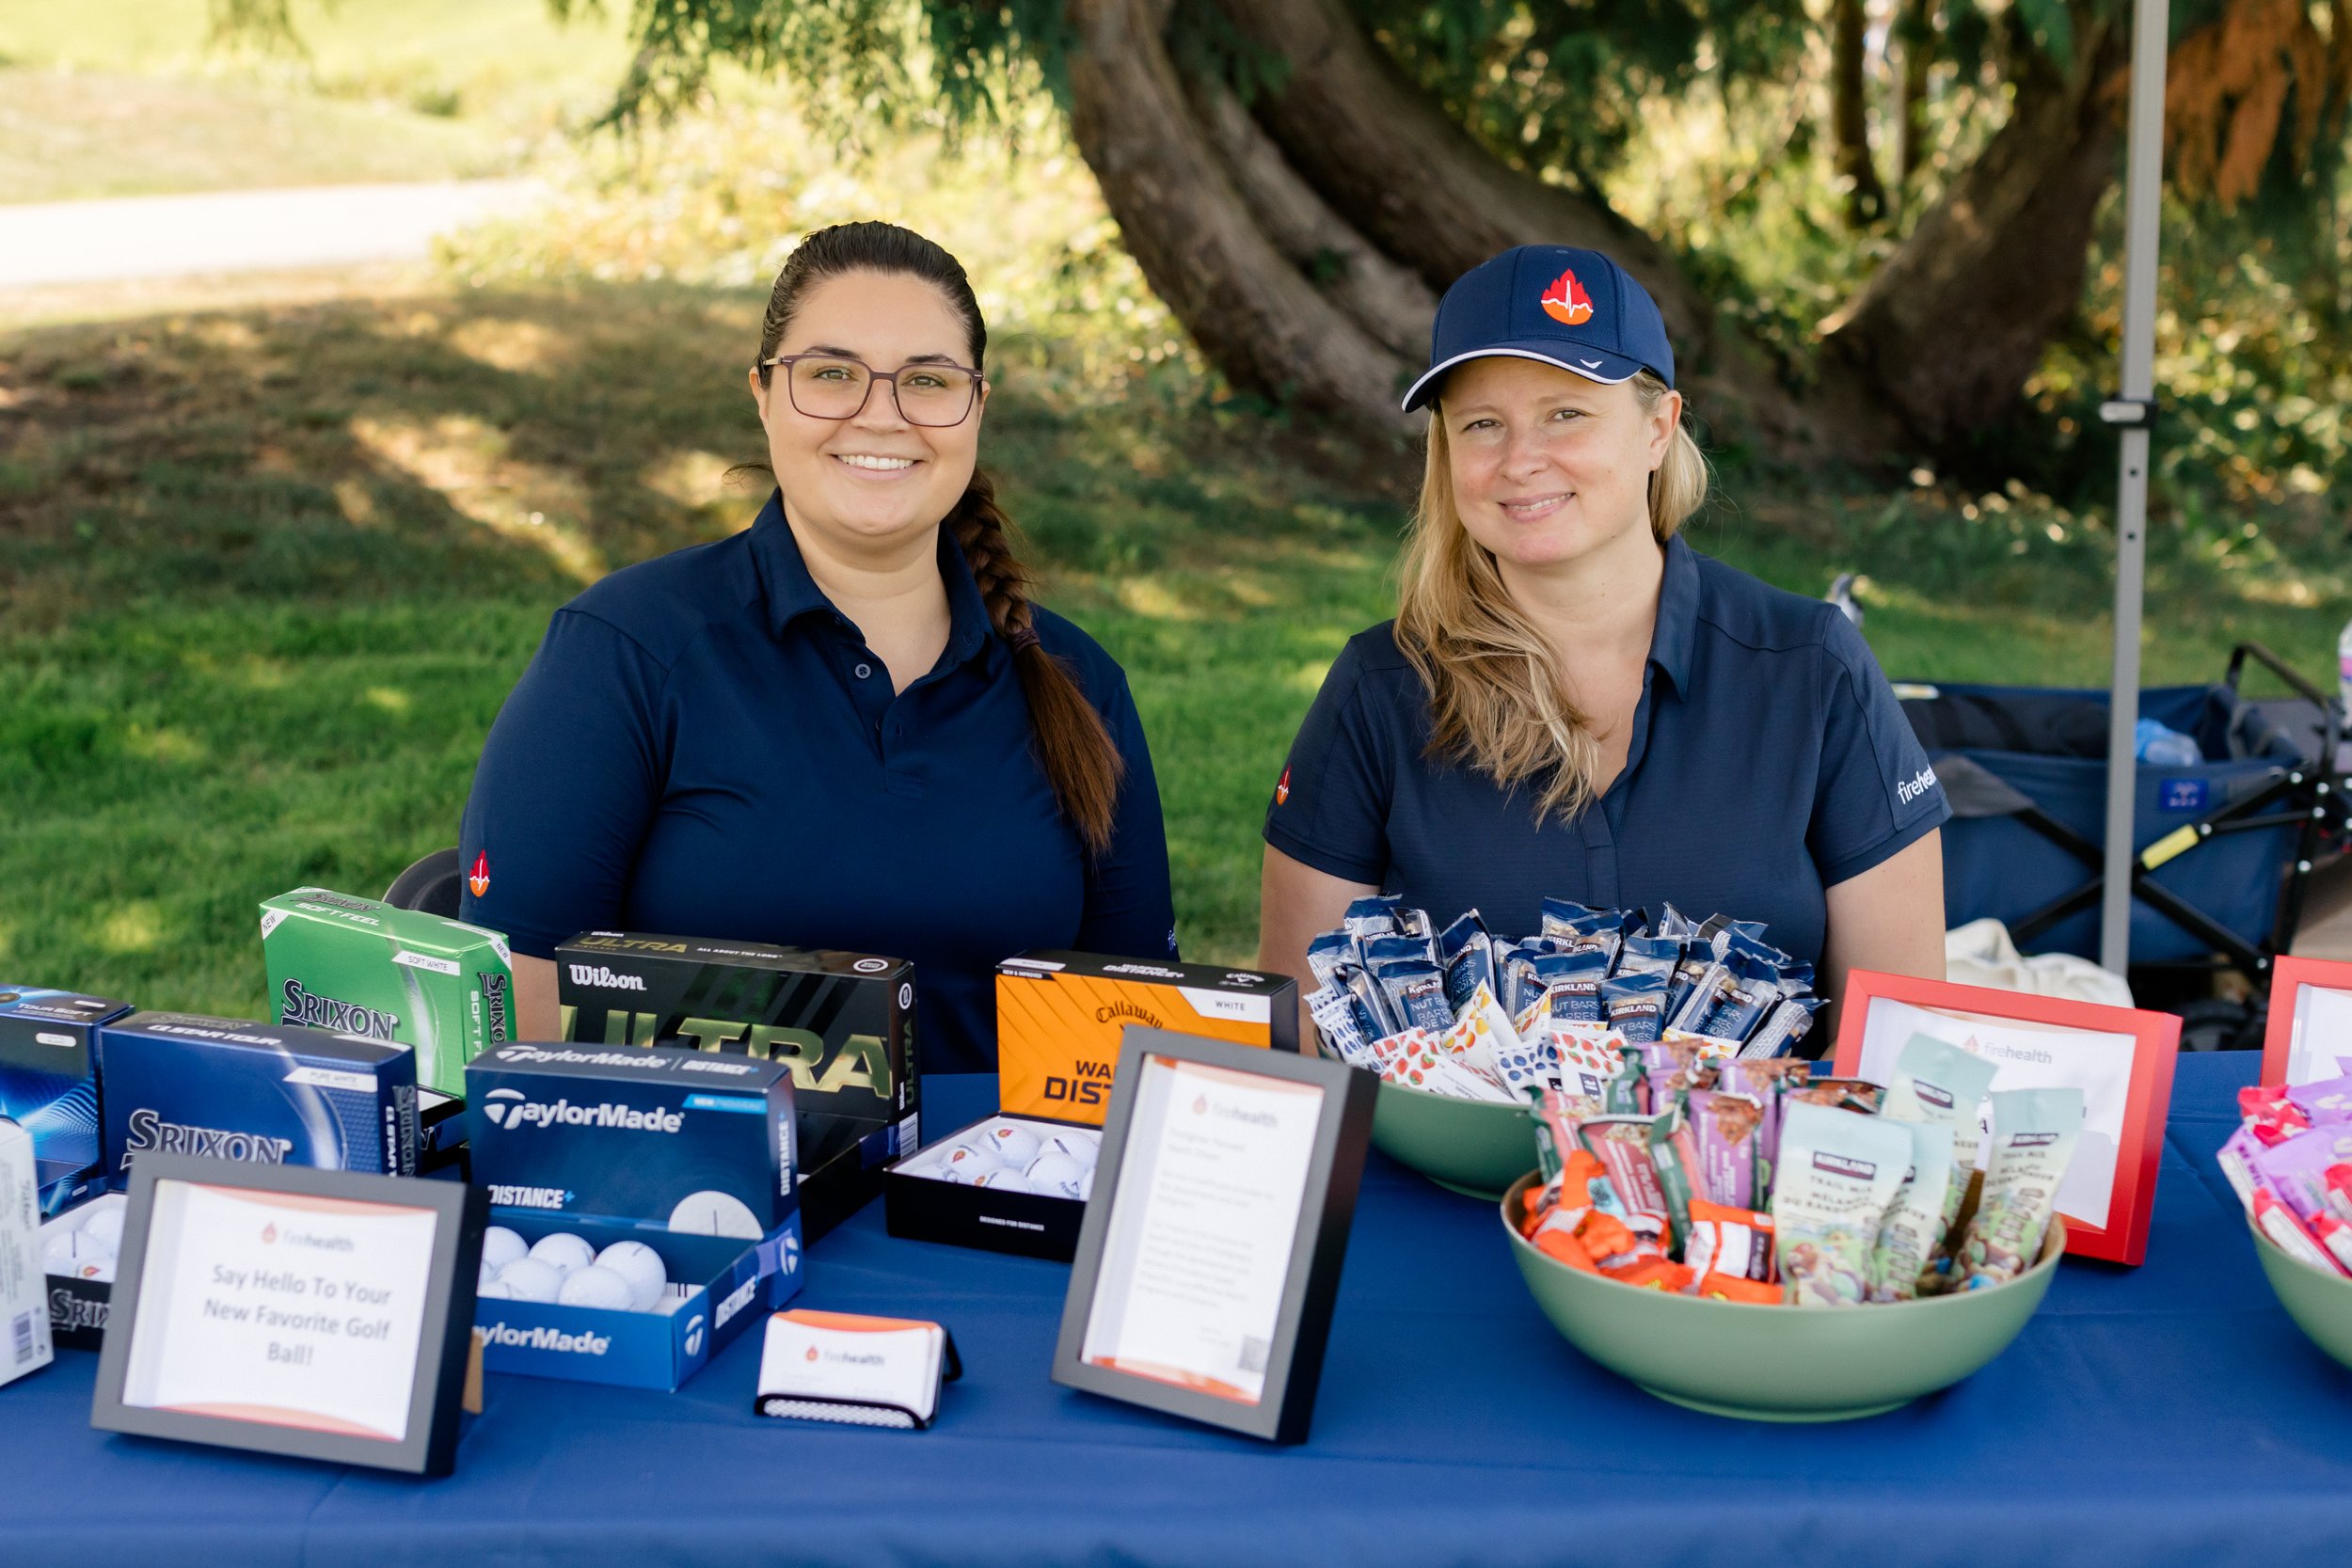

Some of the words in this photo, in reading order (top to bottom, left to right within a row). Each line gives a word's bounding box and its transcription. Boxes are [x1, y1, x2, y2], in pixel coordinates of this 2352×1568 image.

[262, 914, 277, 932] NEW
[295, 903, 342, 916] SOFT
[340, 912, 380, 926] FEEL
[497, 942, 510, 959] NEW
[580, 937, 688, 954] ULTRA
[407, 956, 424, 965] SOFT
[426, 958, 448, 971] WHITE
[569, 964, 647, 991] Wilson
[1551, 983, 1597, 994] KIRKLAND
[282, 978, 400, 1040] SRIXON
[471, 990, 482, 1037] SOFT
[478, 972, 507, 1044] SRIXO
[1095, 1000, 1164, 1030] Callaway
[1215, 1000, 1246, 1012] WHITE
[1412, 998, 1434, 1011] NUT
[1571, 1000, 1600, 1011] BARS
[1610, 1004, 1657, 1018] KIRKLAND
[1423, 1017, 1438, 1029] DE
[1627, 1021, 1657, 1033] BARS
[496, 1045, 673, 1069] TaylorMade
[1984, 1041, 2053, 1065] firehealth
[484, 1087, 685, 1134] TaylorMade
[125, 1108, 293, 1164] SRIXON
[213, 1264, 247, 1291] Say
[253, 1270, 306, 1294] Hello
[313, 1276, 338, 1299] To
[344, 1281, 392, 1306] Your
[203, 1299, 250, 1323] New
[256, 1305, 341, 1335] Favorite
[345, 1317, 392, 1340] Golf
[267, 1341, 314, 1367] Ball!
